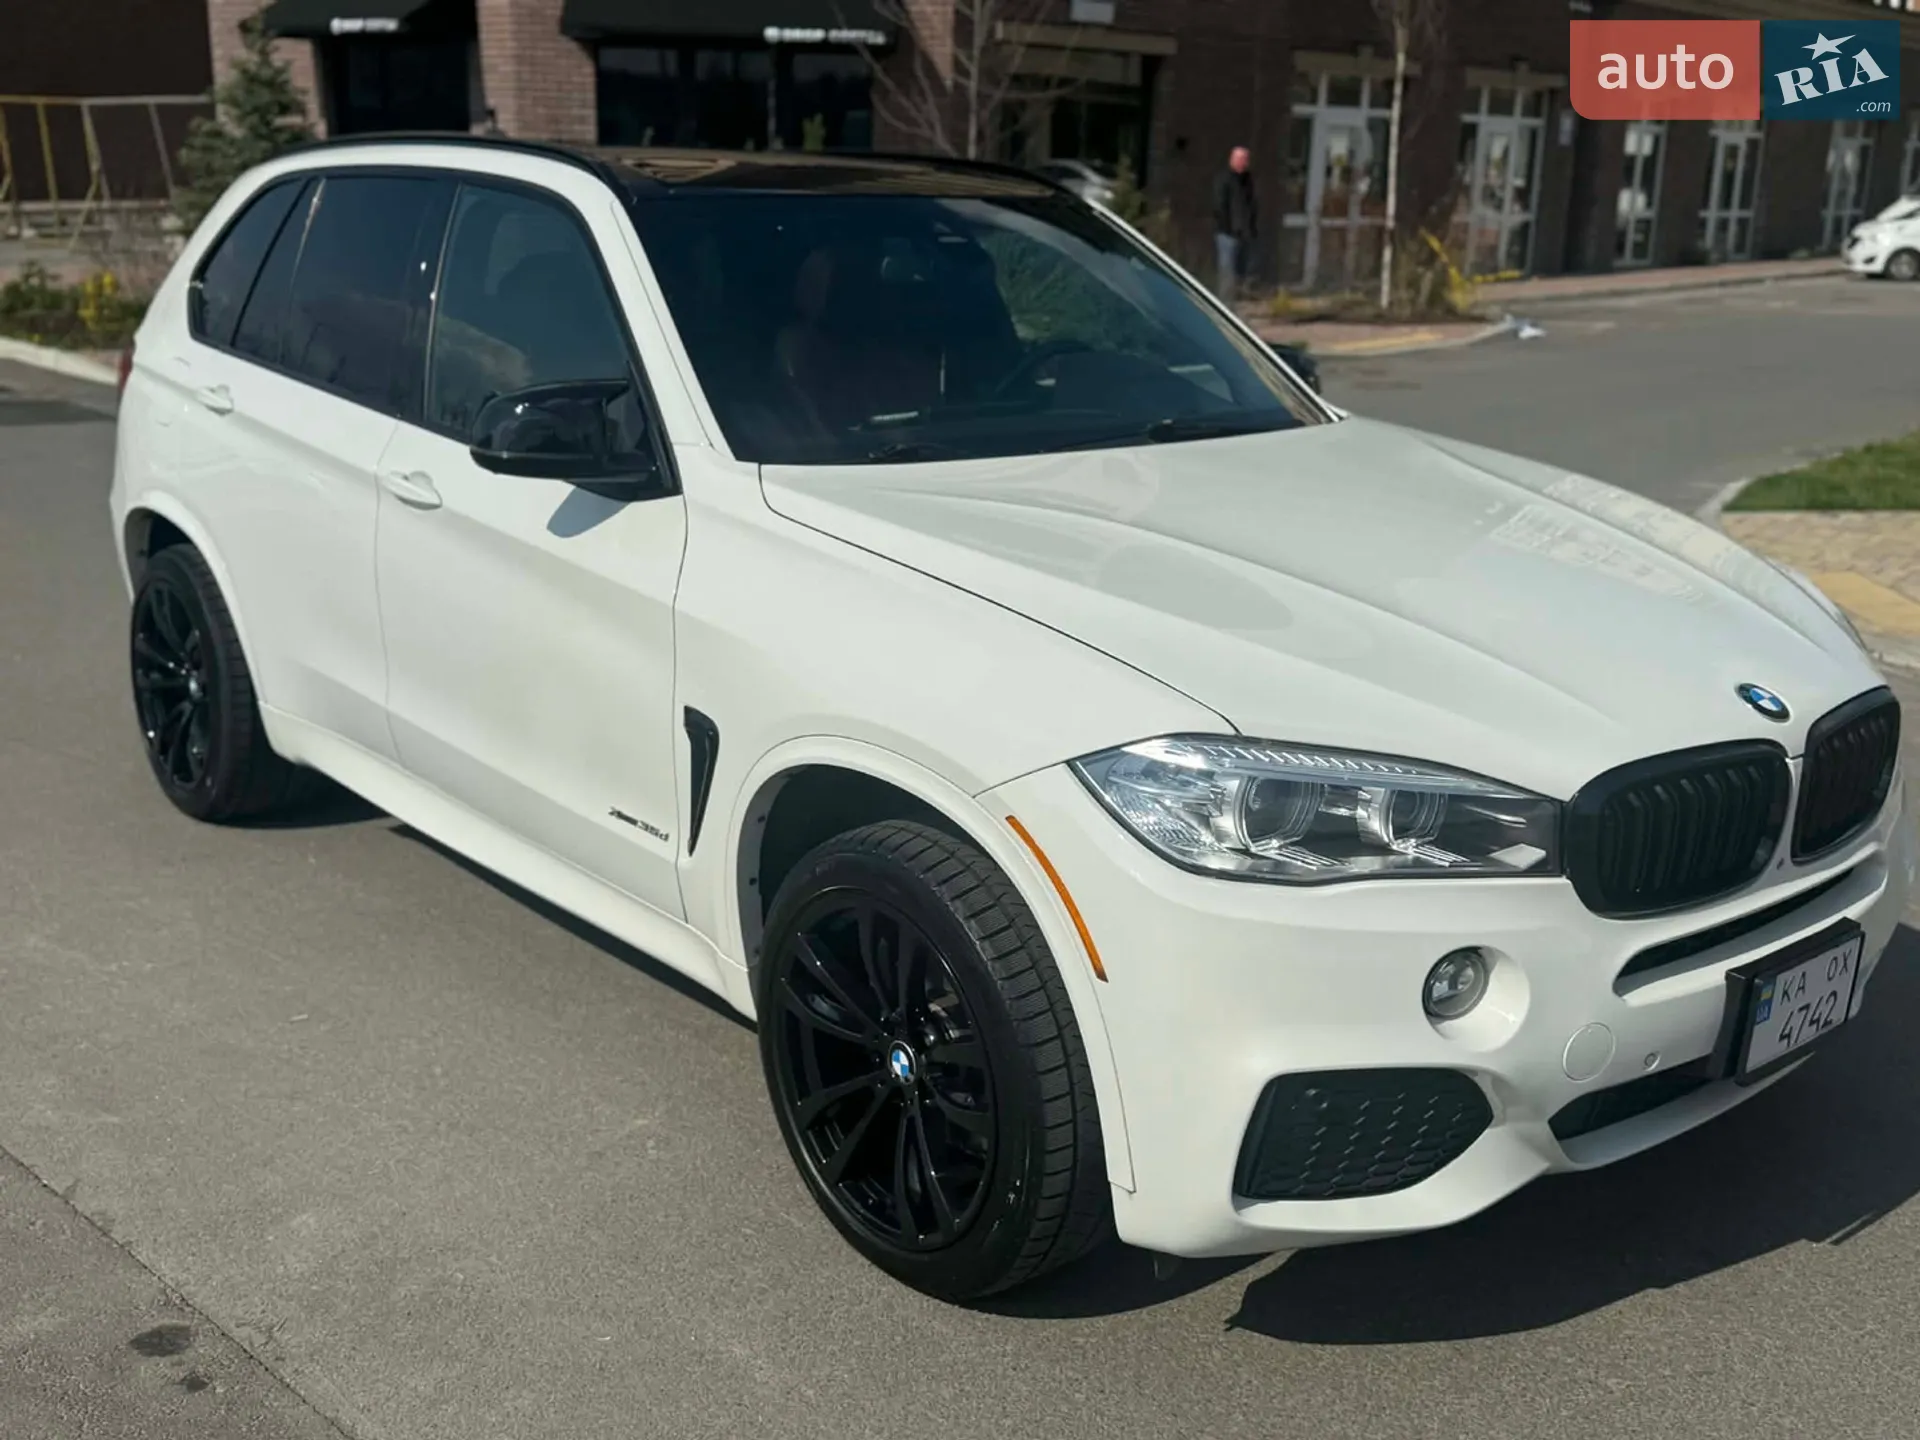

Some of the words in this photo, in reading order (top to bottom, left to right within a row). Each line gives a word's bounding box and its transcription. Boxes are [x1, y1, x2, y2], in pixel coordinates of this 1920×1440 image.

[1780, 971, 1807, 1005] KA
[1827, 949, 1853, 982] OX
[1778, 990, 1838, 1048] 4742
